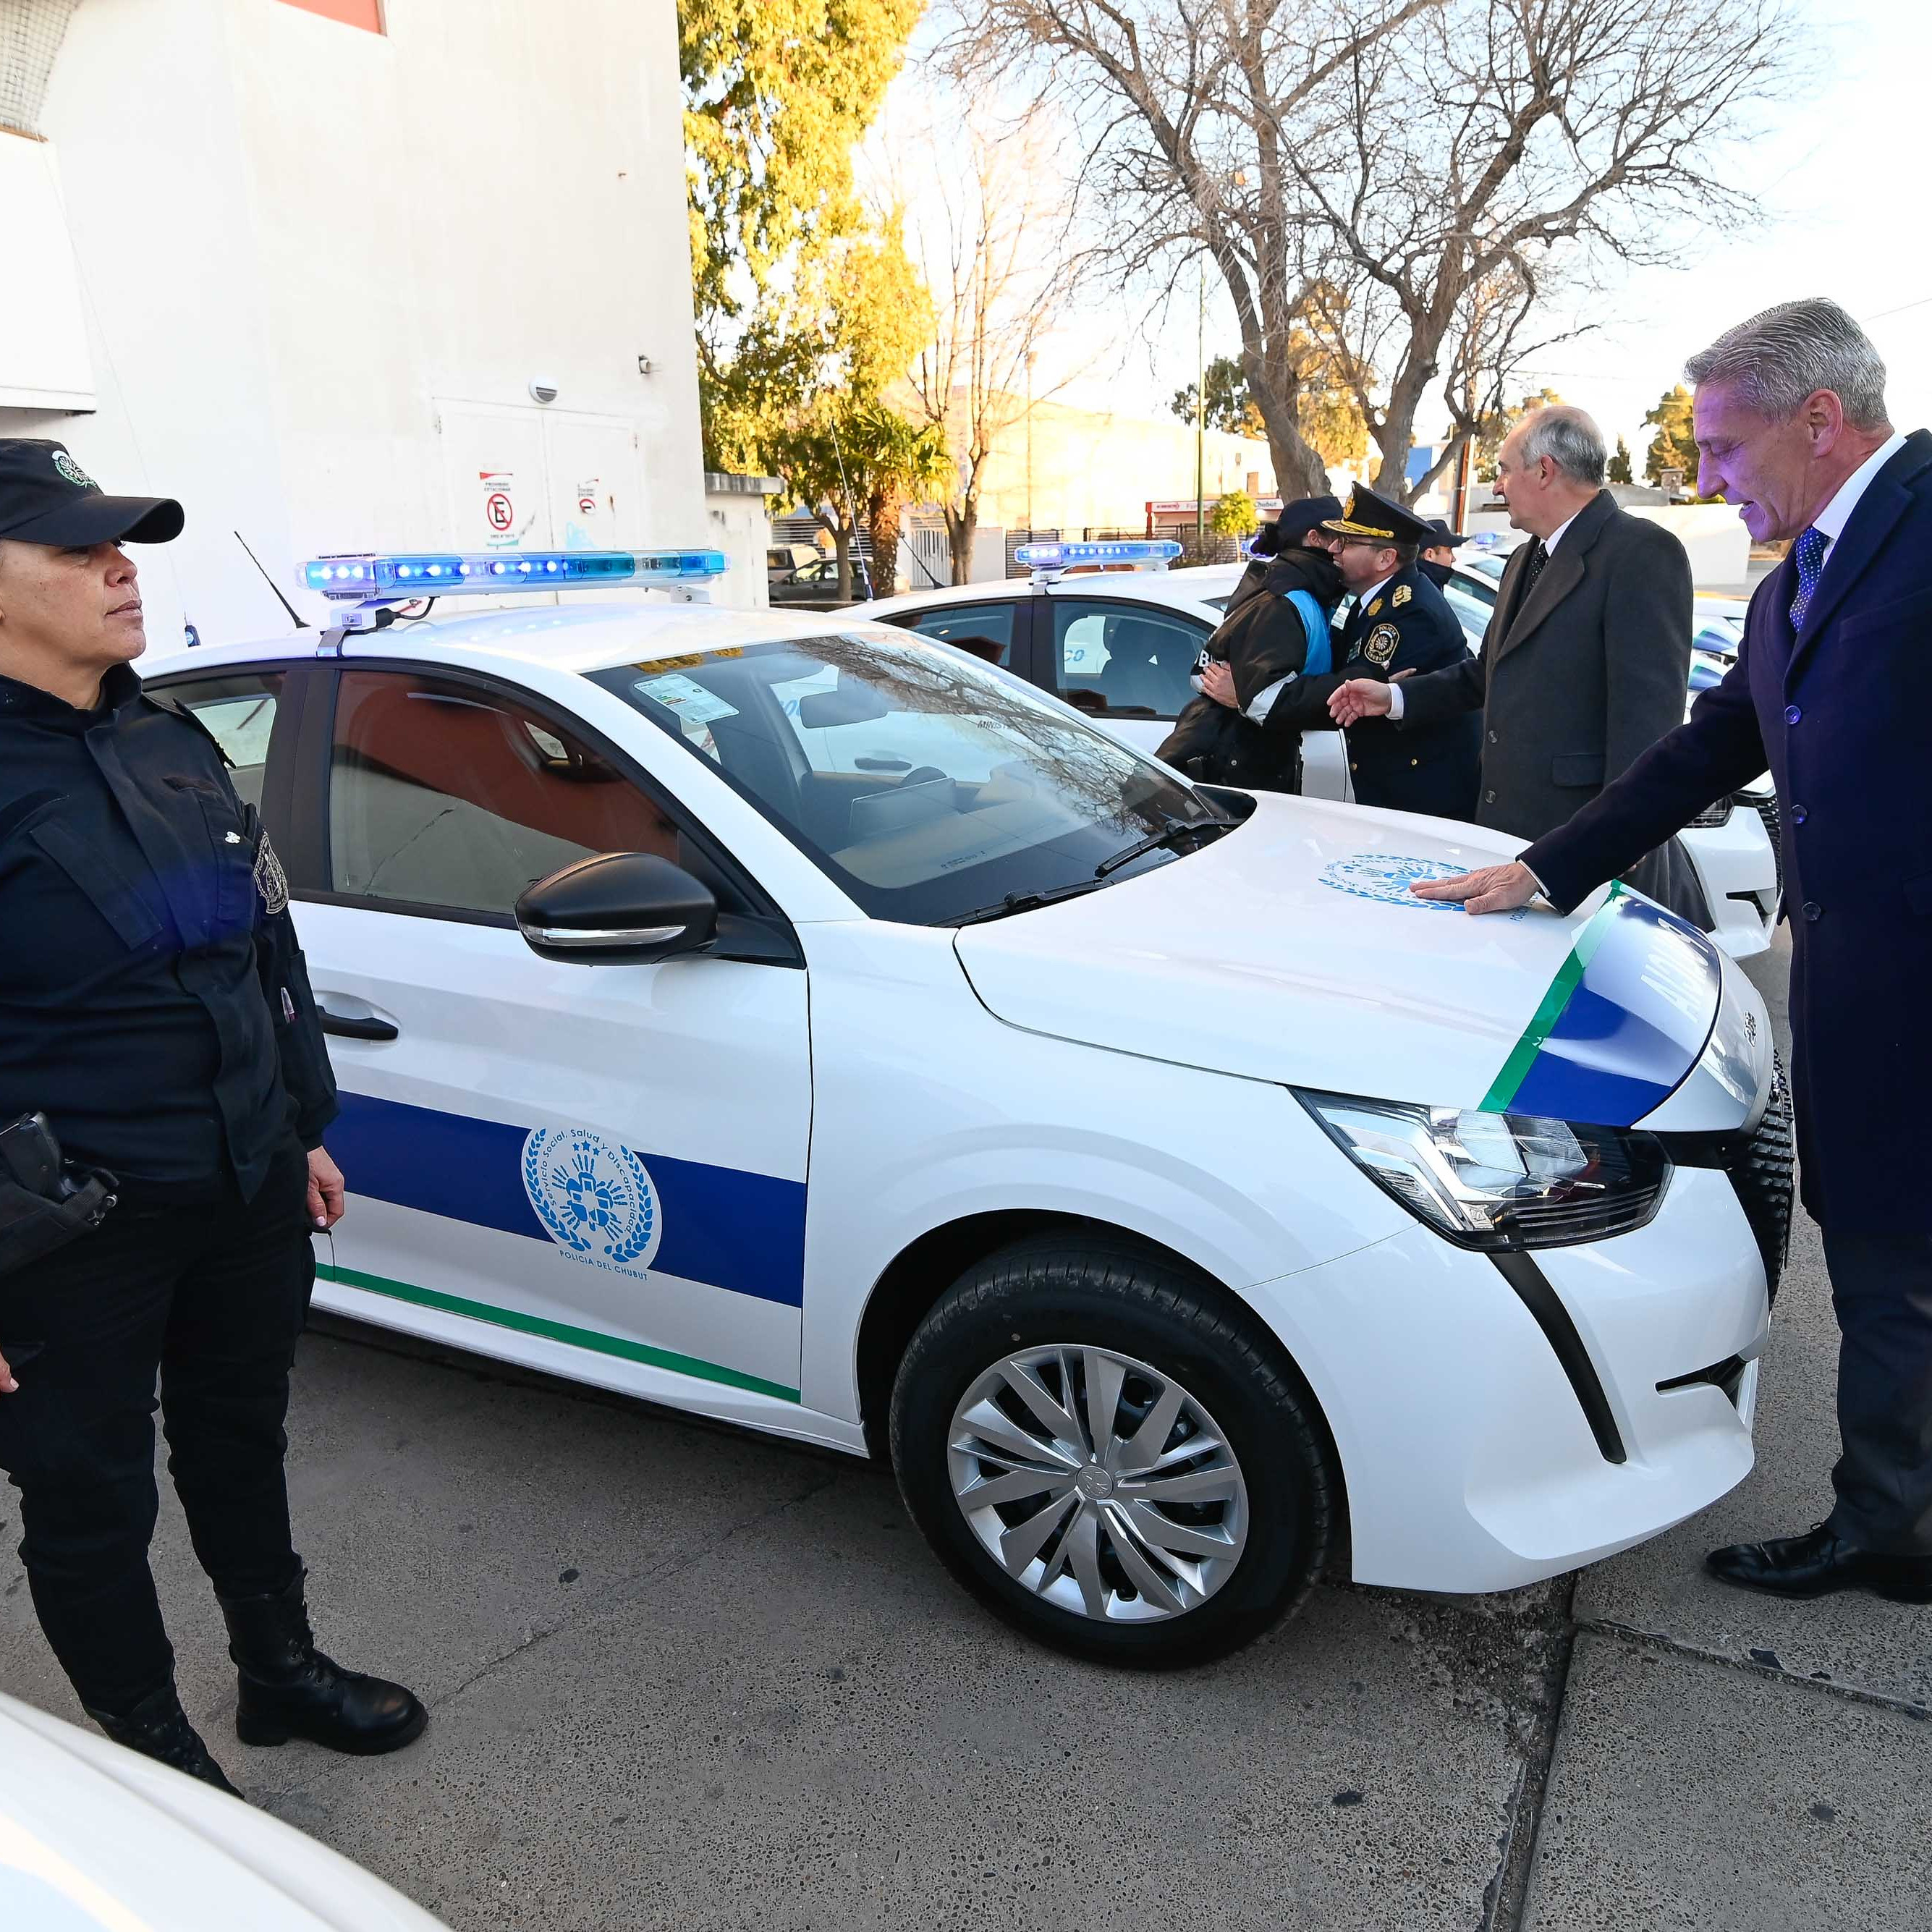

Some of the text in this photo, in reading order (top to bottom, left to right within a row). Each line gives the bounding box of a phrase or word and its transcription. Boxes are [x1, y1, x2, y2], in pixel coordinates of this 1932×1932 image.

[541, 1161, 556, 1206] Servicio
[570, 1129, 600, 1143] Salud
[559, 1250, 648, 1281] POLICIA DEL CHUBUT
